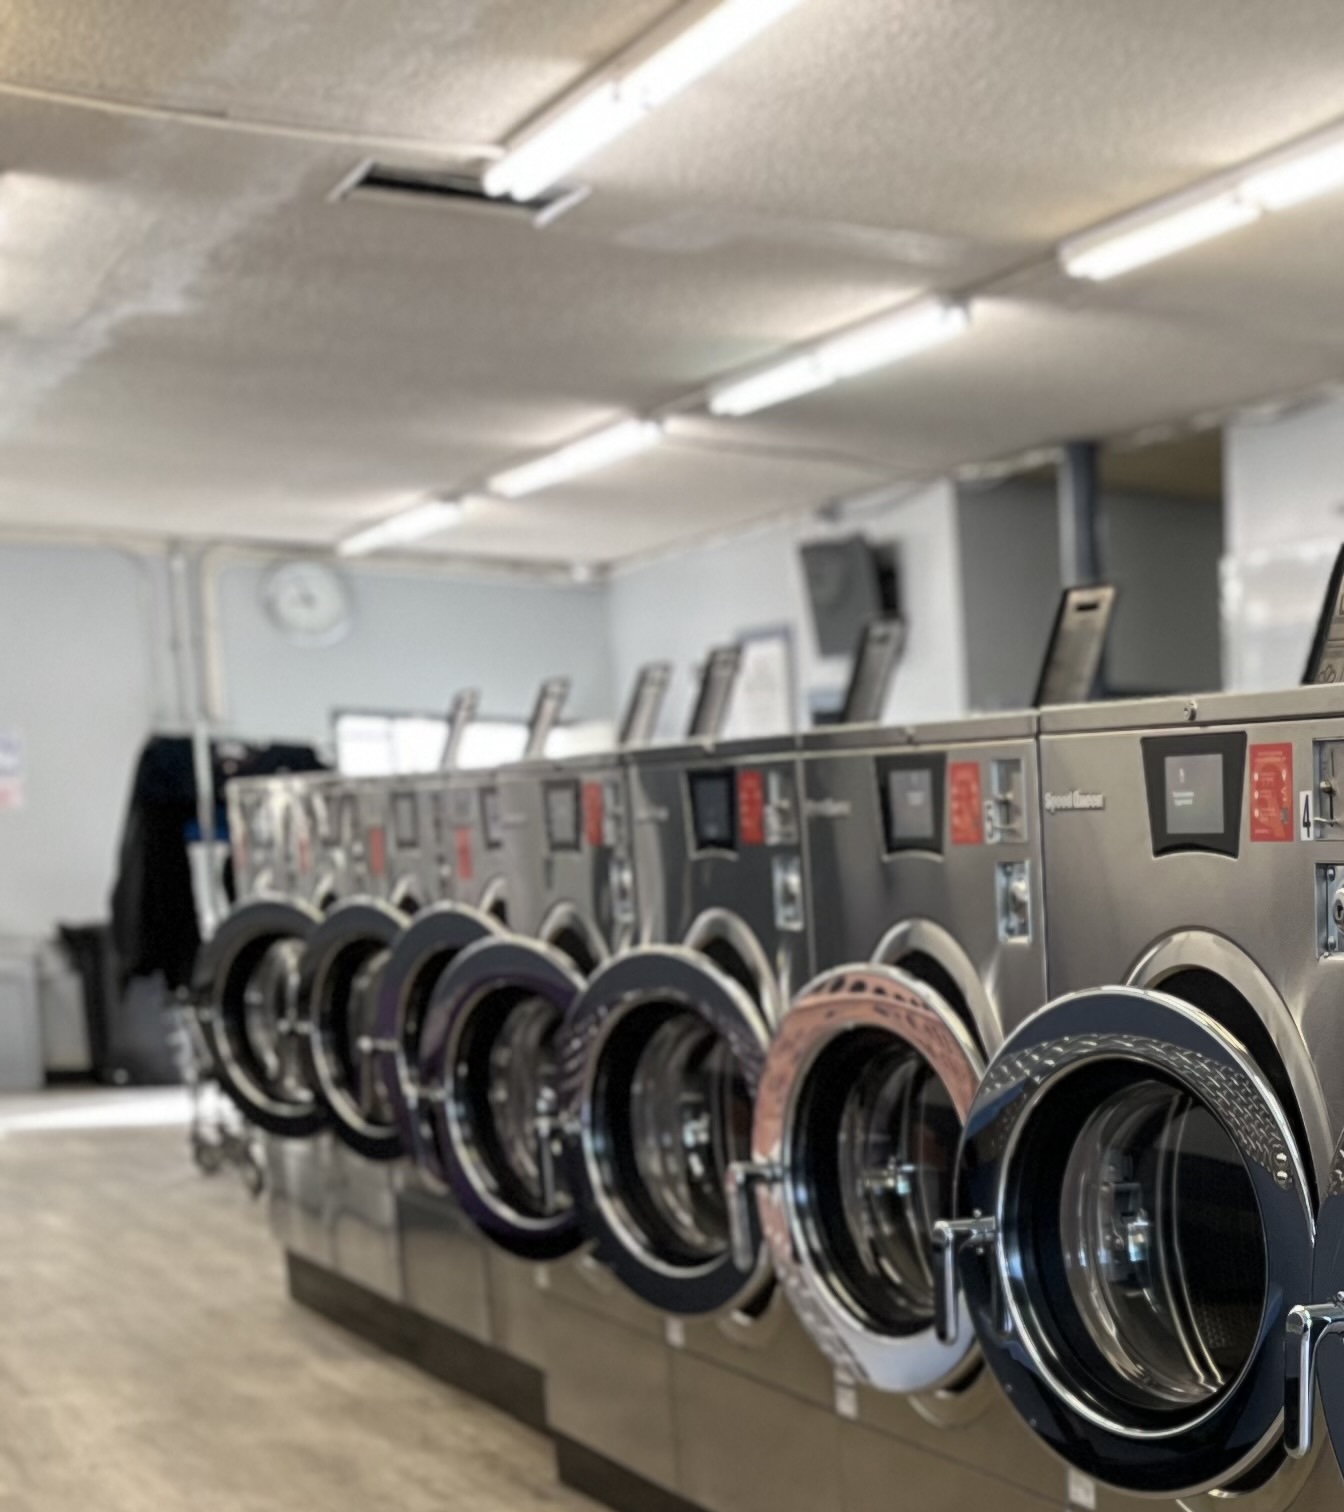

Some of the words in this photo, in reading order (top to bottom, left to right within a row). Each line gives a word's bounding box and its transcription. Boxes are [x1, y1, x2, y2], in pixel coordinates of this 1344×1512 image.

[1045, 790, 1073, 815] Speed
[1073, 789, 1104, 810] Queen
[1303, 794, 1311, 839] 4
